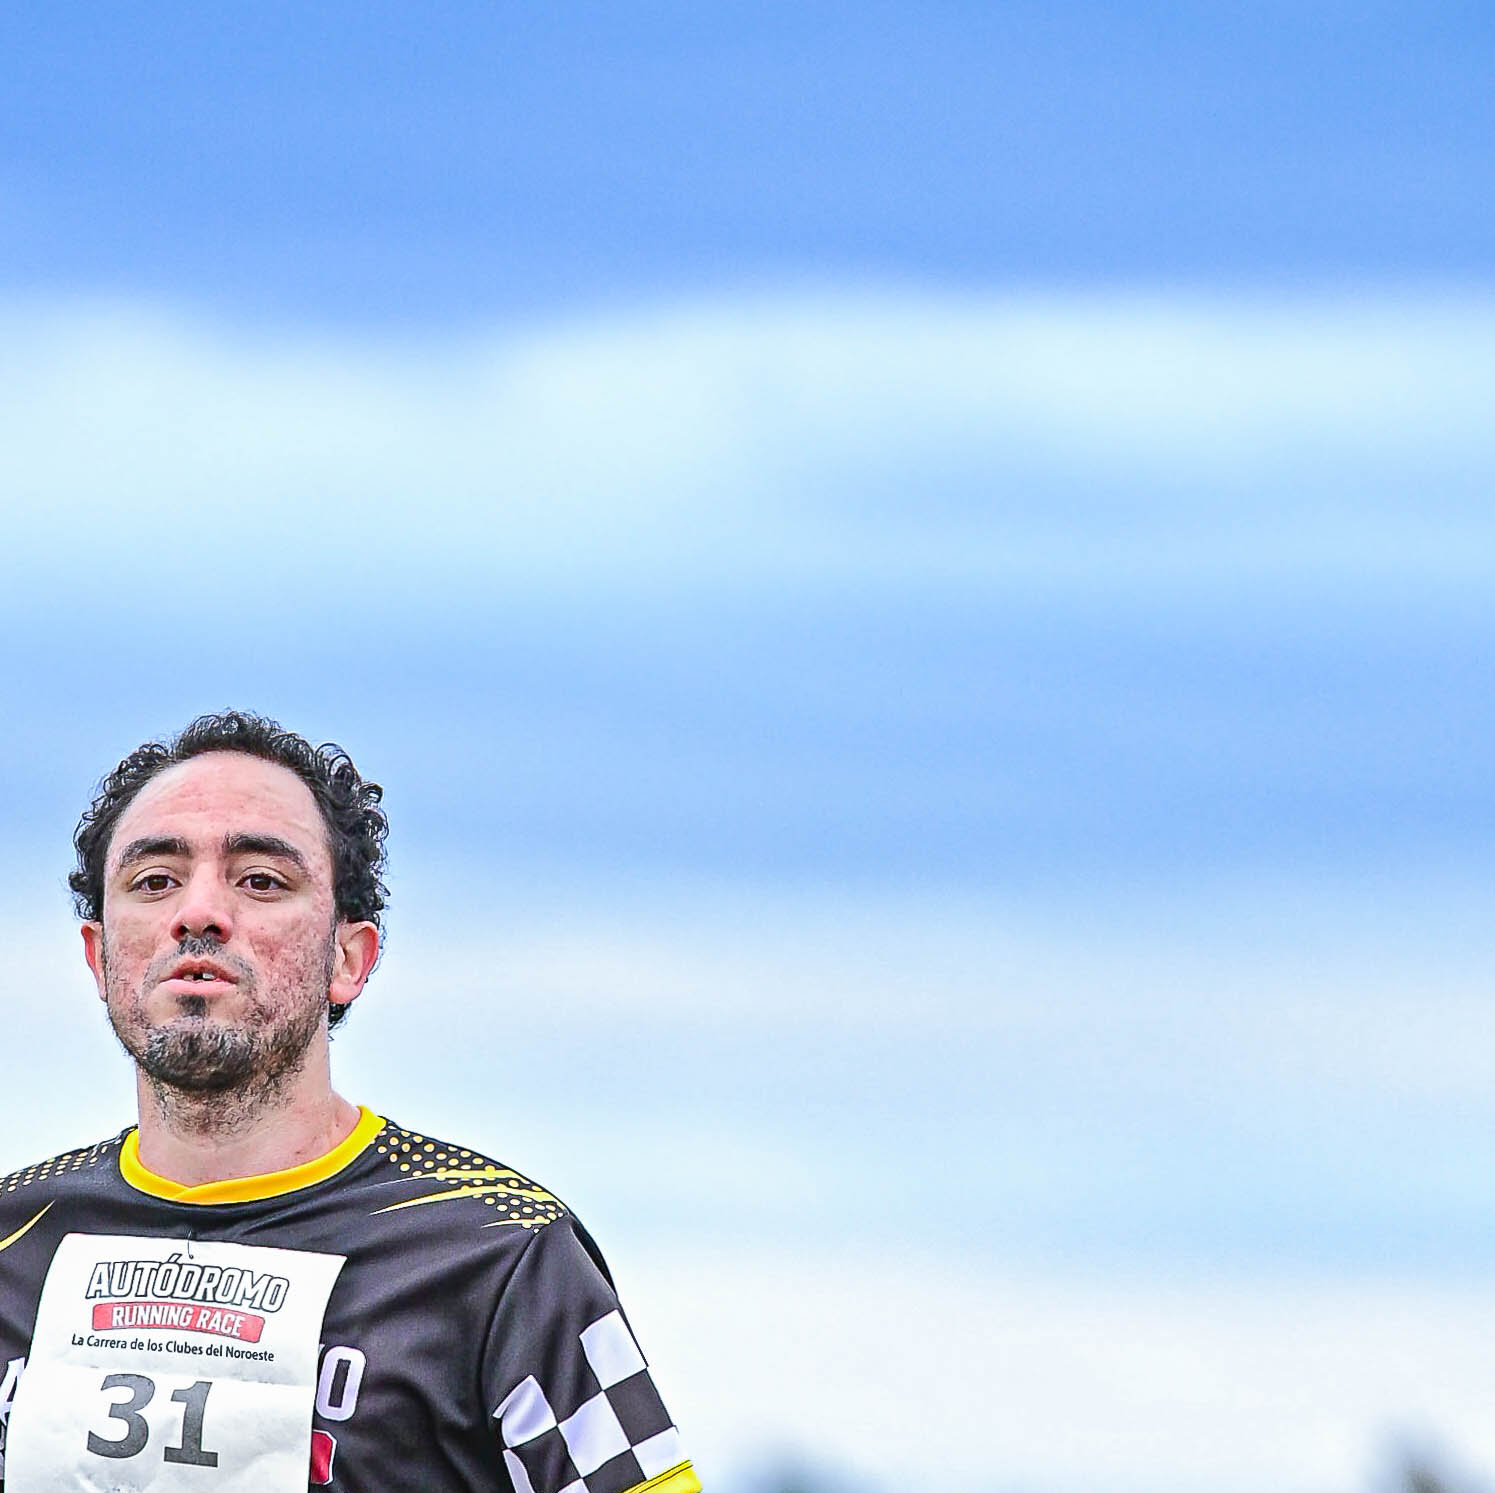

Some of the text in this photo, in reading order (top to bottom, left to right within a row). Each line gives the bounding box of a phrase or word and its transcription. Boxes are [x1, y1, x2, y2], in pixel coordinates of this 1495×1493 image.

[85, 1253, 289, 1313] AUTÓDROMO
[111, 1305, 247, 1337] RUNNING RACE
[71, 1333, 275, 1362] La Carrera de los Clubes del Noroeste
[87, 1373, 218, 1467] 31
